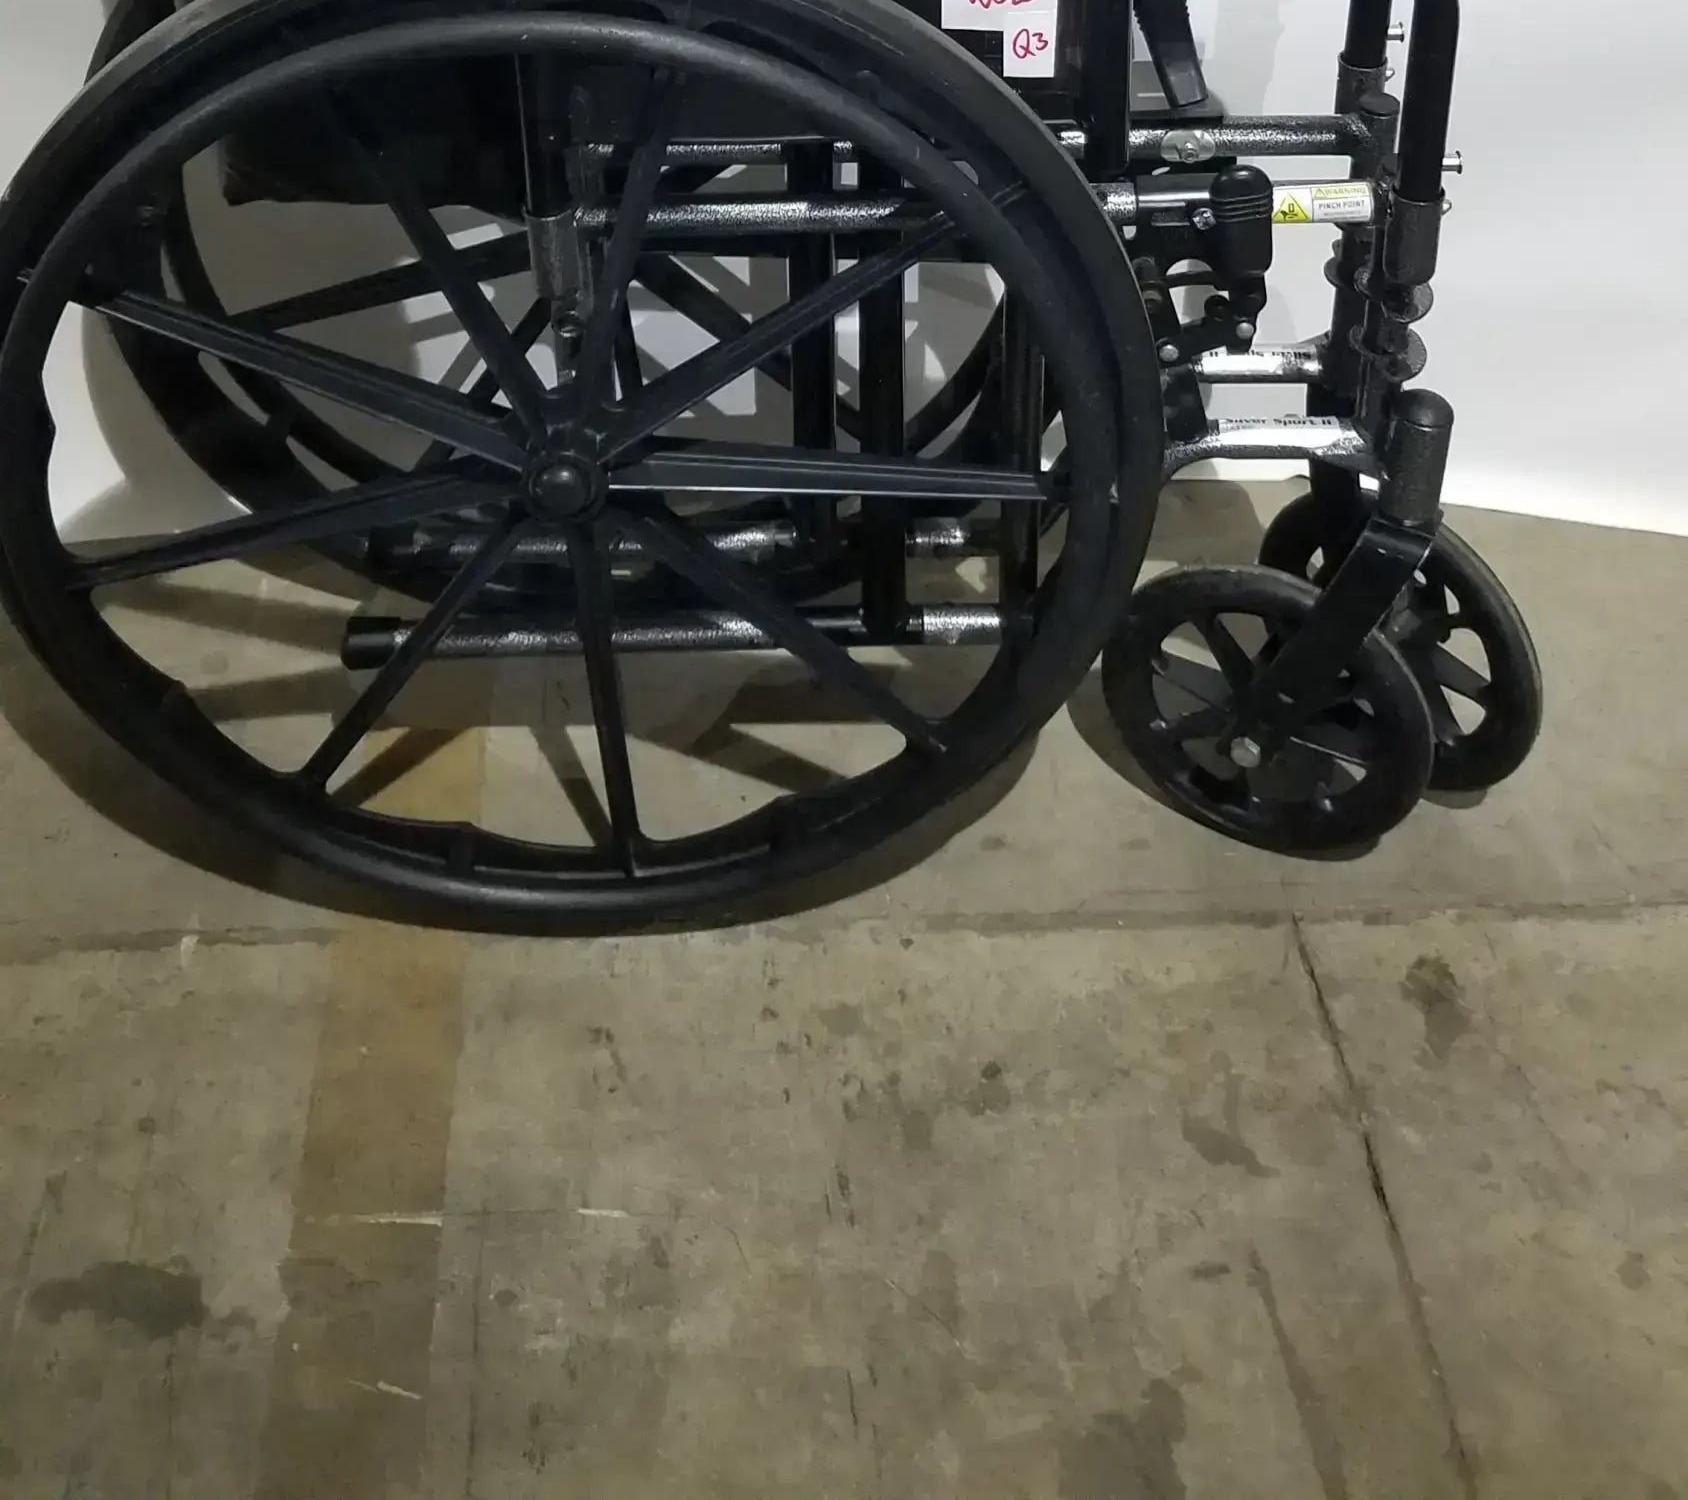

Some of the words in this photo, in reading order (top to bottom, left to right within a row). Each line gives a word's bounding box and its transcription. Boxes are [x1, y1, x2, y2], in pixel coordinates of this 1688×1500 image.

[1012, 28, 1049, 60] Q3
[1325, 187, 1367, 196] WARNING
[1318, 202, 1341, 210] PINCH
[1342, 199, 1365, 208] POINT
